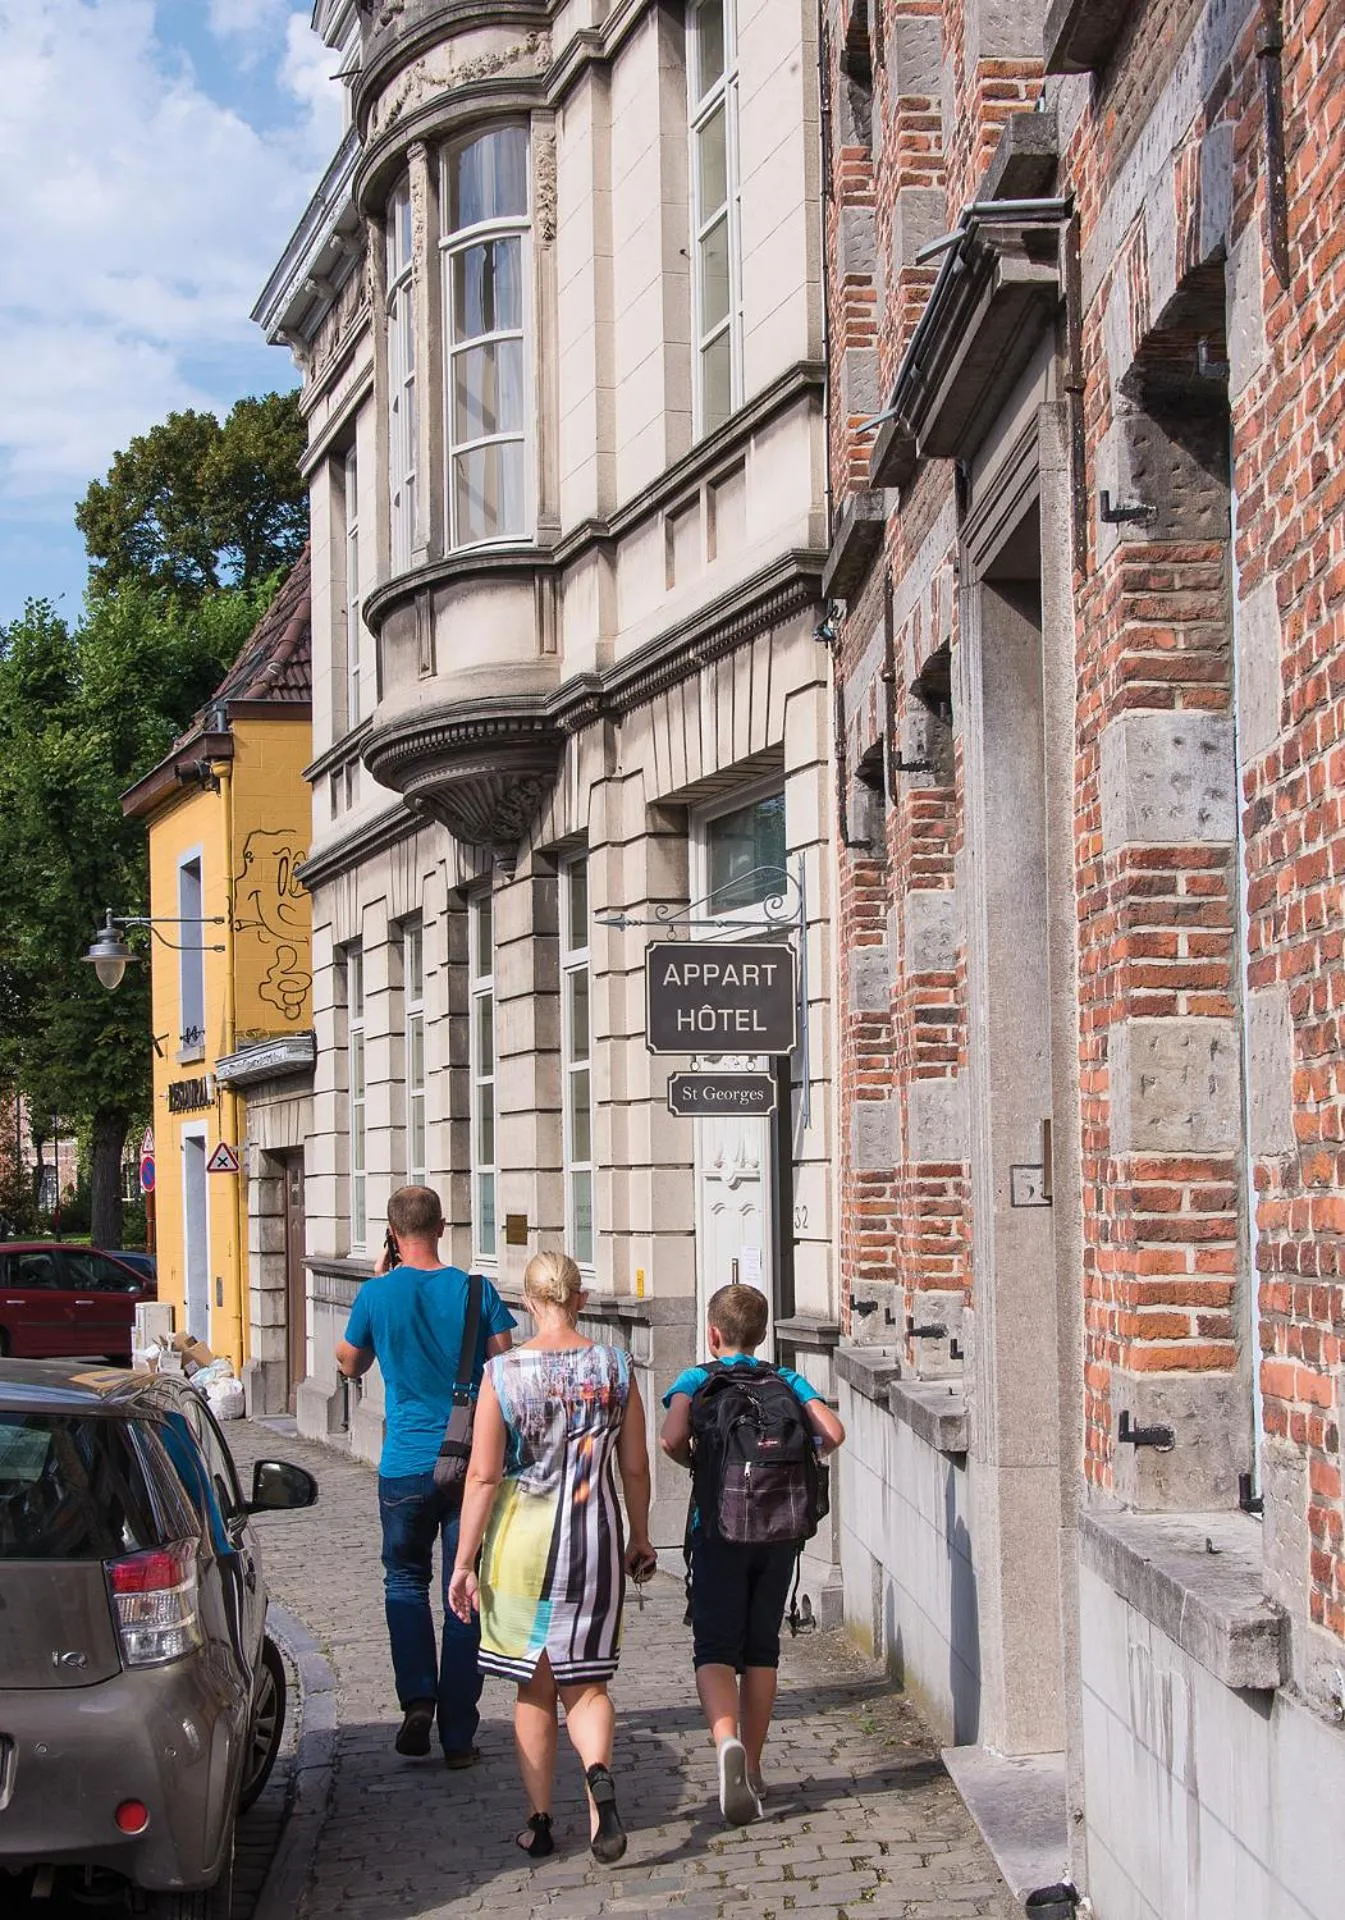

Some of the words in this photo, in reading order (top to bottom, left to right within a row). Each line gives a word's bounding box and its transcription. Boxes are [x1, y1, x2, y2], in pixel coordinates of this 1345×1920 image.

[662, 963, 777, 987] APPART
[677, 1004, 767, 1031] HÔTEL
[682, 1086, 698, 1101] St
[702, 1086, 764, 1105] Georges
[794, 1205, 809, 1229] 32
